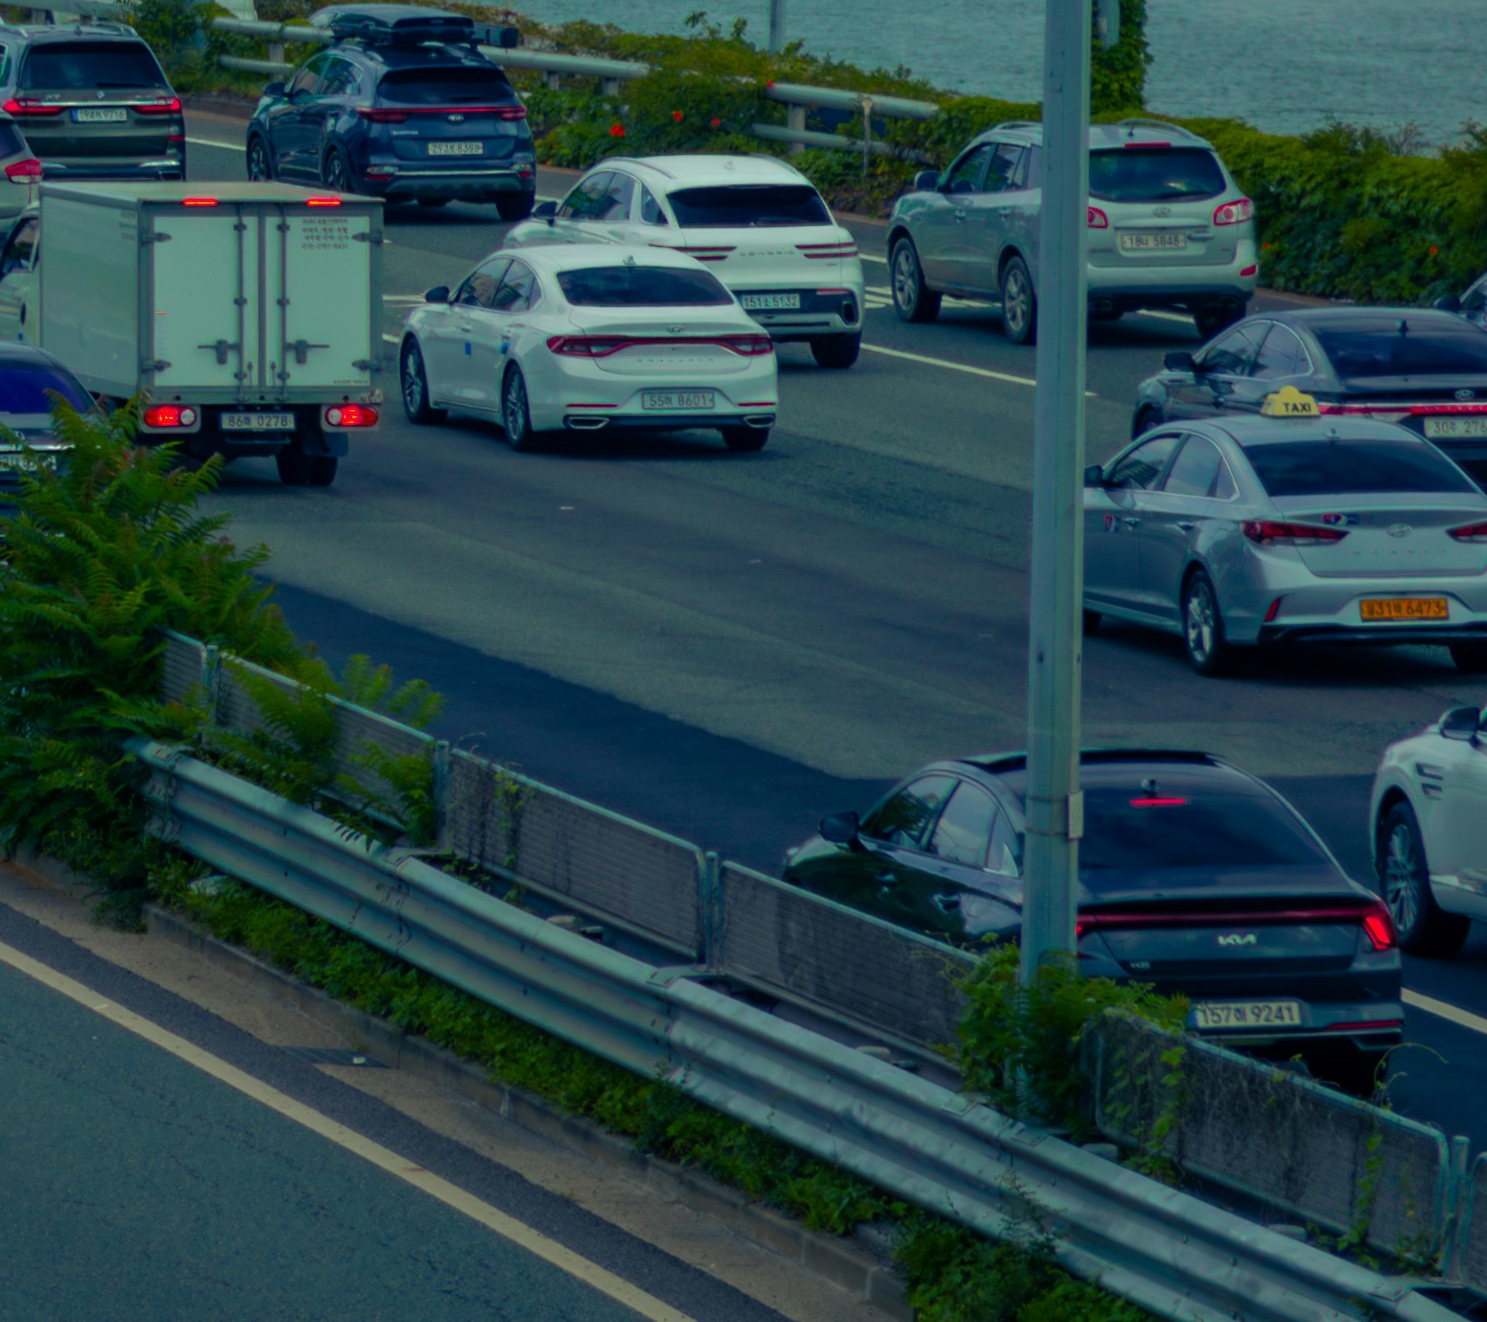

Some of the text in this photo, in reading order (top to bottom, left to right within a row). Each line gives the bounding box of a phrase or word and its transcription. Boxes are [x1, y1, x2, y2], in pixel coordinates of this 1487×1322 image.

[678, 395, 707, 406] 8601
[1283, 402, 1311, 413] TAXI
[258, 414, 288, 427] 0278
[1405, 600, 1442, 614] 6473
[1251, 1002, 1296, 1021] 9241
